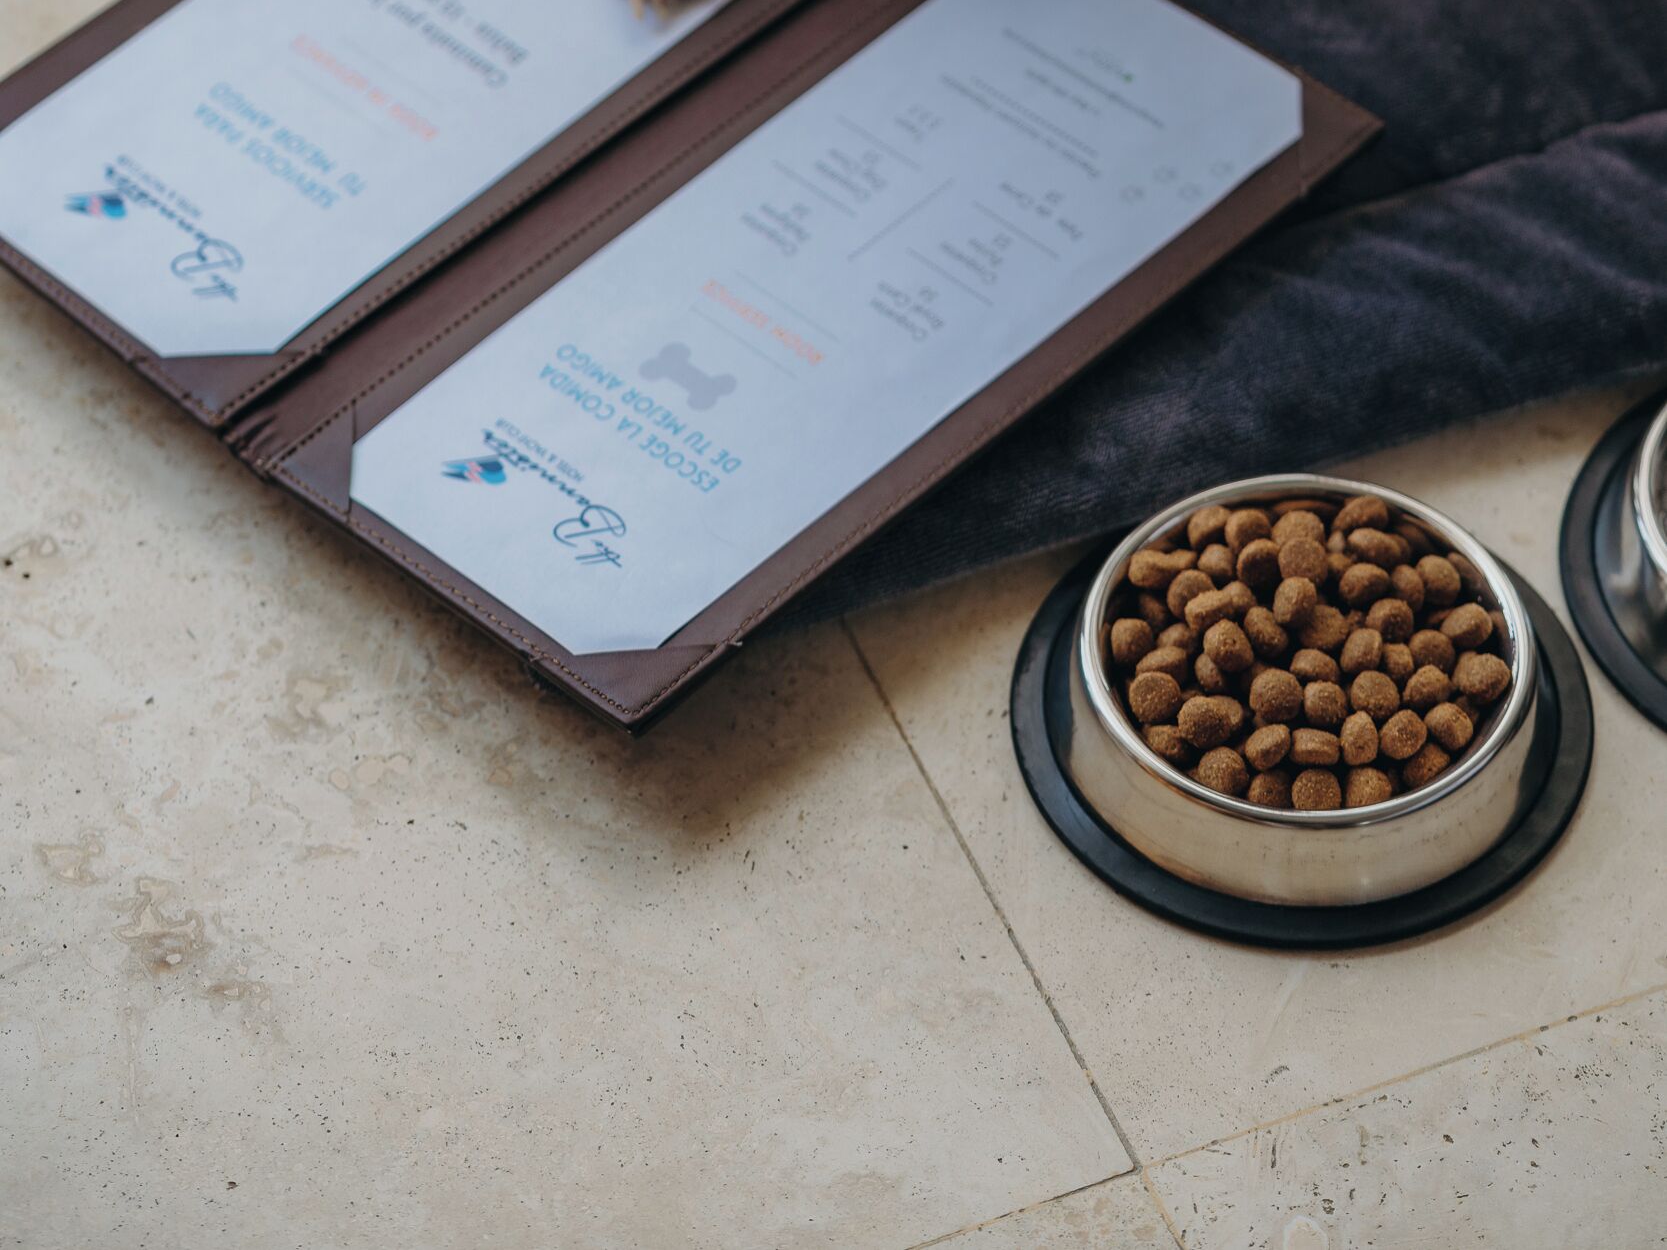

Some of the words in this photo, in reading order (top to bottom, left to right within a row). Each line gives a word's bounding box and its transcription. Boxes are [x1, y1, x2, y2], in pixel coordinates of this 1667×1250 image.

[385, 0, 428, 29] por
[191, 101, 246, 145] PARA
[207, 81, 276, 131] AMIGO
[239, 136, 342, 211] SERVICIOS
[270, 126, 337, 176] MEJOR
[336, 171, 366, 197] TU
[698, 277, 774, 331] SERVICE
[553, 342, 626, 393] AMIGO
[767, 323, 827, 367] ROOM
[536, 362, 618, 422] COMIDA
[618, 386, 688, 437] MEJOR
[614, 414, 645, 440] LA
[681, 429, 714, 457] TU
[636, 432, 722, 494] ESCOGE
[708, 448, 744, 475] DE
[483, 430, 626, 547] Bannister
[575, 538, 623, 569] the
